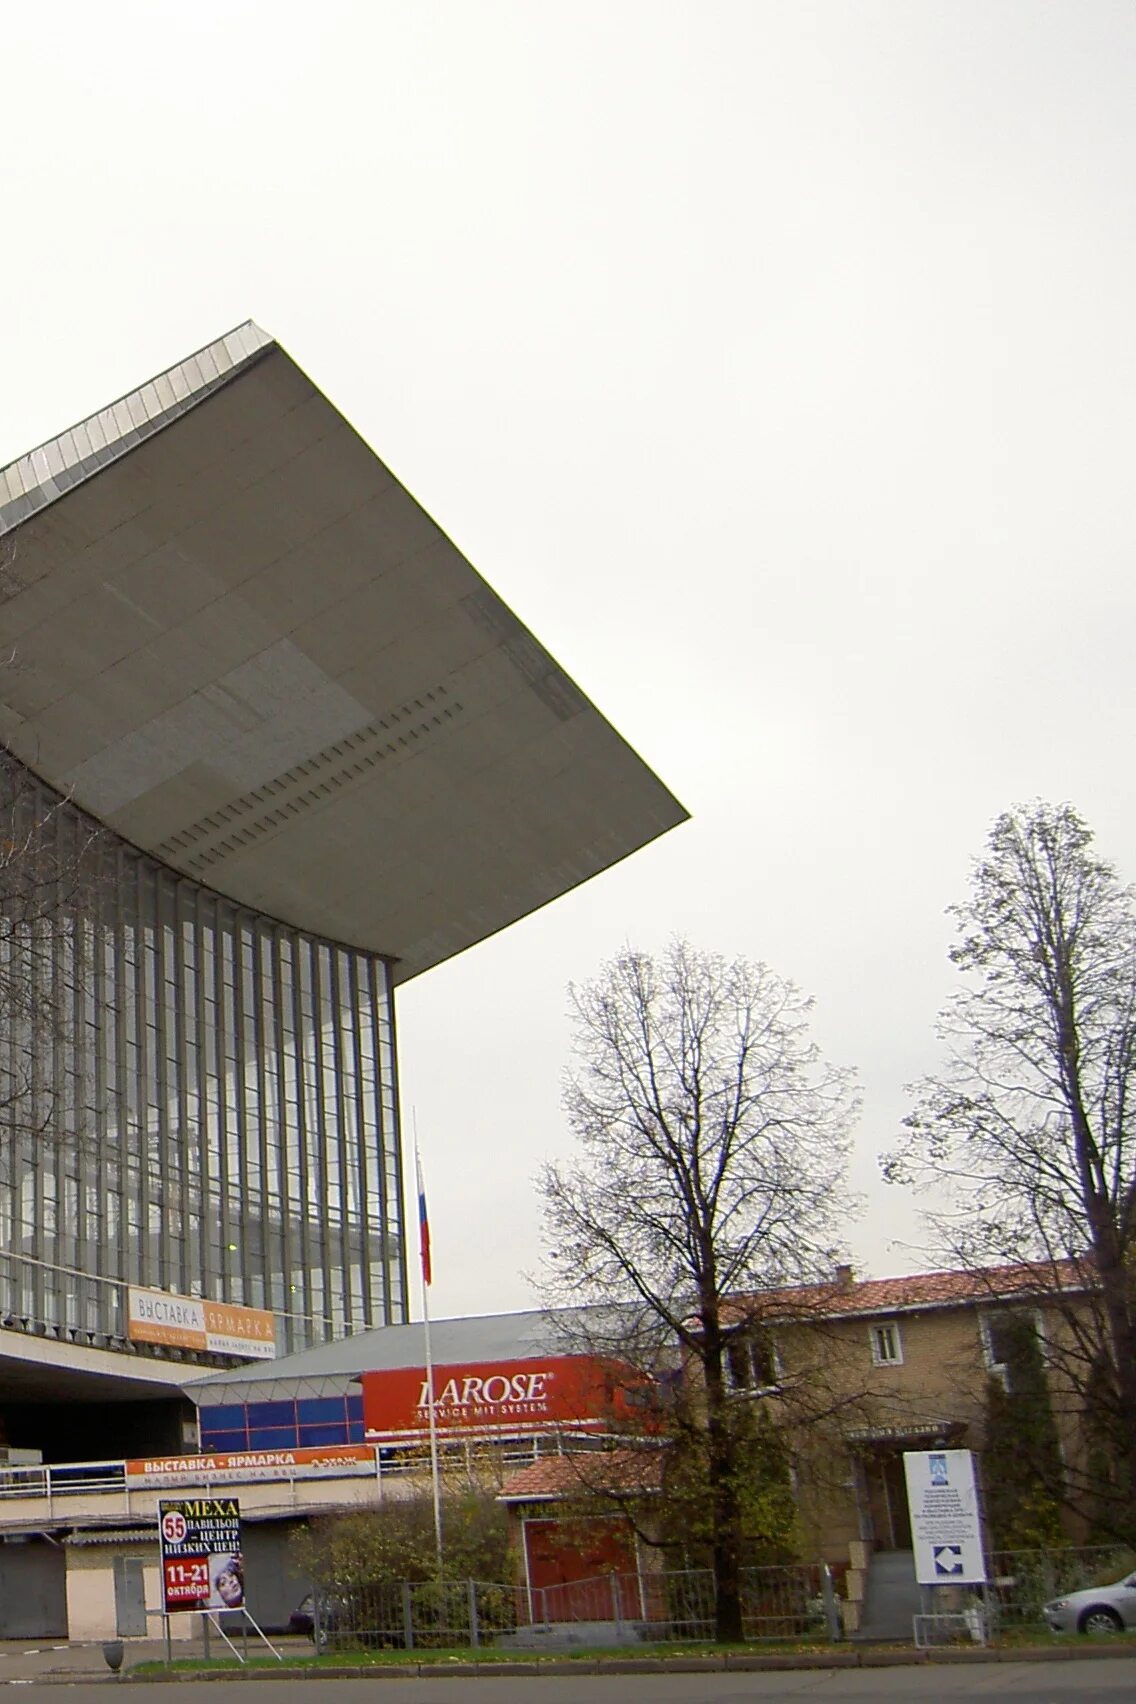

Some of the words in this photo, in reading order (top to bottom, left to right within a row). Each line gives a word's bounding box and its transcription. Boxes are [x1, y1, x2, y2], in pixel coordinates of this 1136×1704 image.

[139, 1299, 199, 1327] ВЫСТАВКА
[209, 1312, 273, 1337] ЯРМАРКА
[417, 1373, 547, 1407] LAROSE
[474, 1405, 494, 1416] MIT
[501, 1403, 547, 1414] SYSTEM
[144, 1458, 216, 1472] ВЫСТАВКА
[228, 1453, 295, 1467] ЯРМАРКА
[185, 1500, 239, 1516] МЕХА
[165, 1518, 184, 1539] 55
[187, 1518, 239, 1530] ПАВИЛЬОН
[200, 1530, 238, 1542] ЦЕНТР
[164, 1543, 211, 1554] НИЗКИХ
[214, 1541, 240, 1552] ЦЕН!
[167, 1582, 209, 1597] октября
